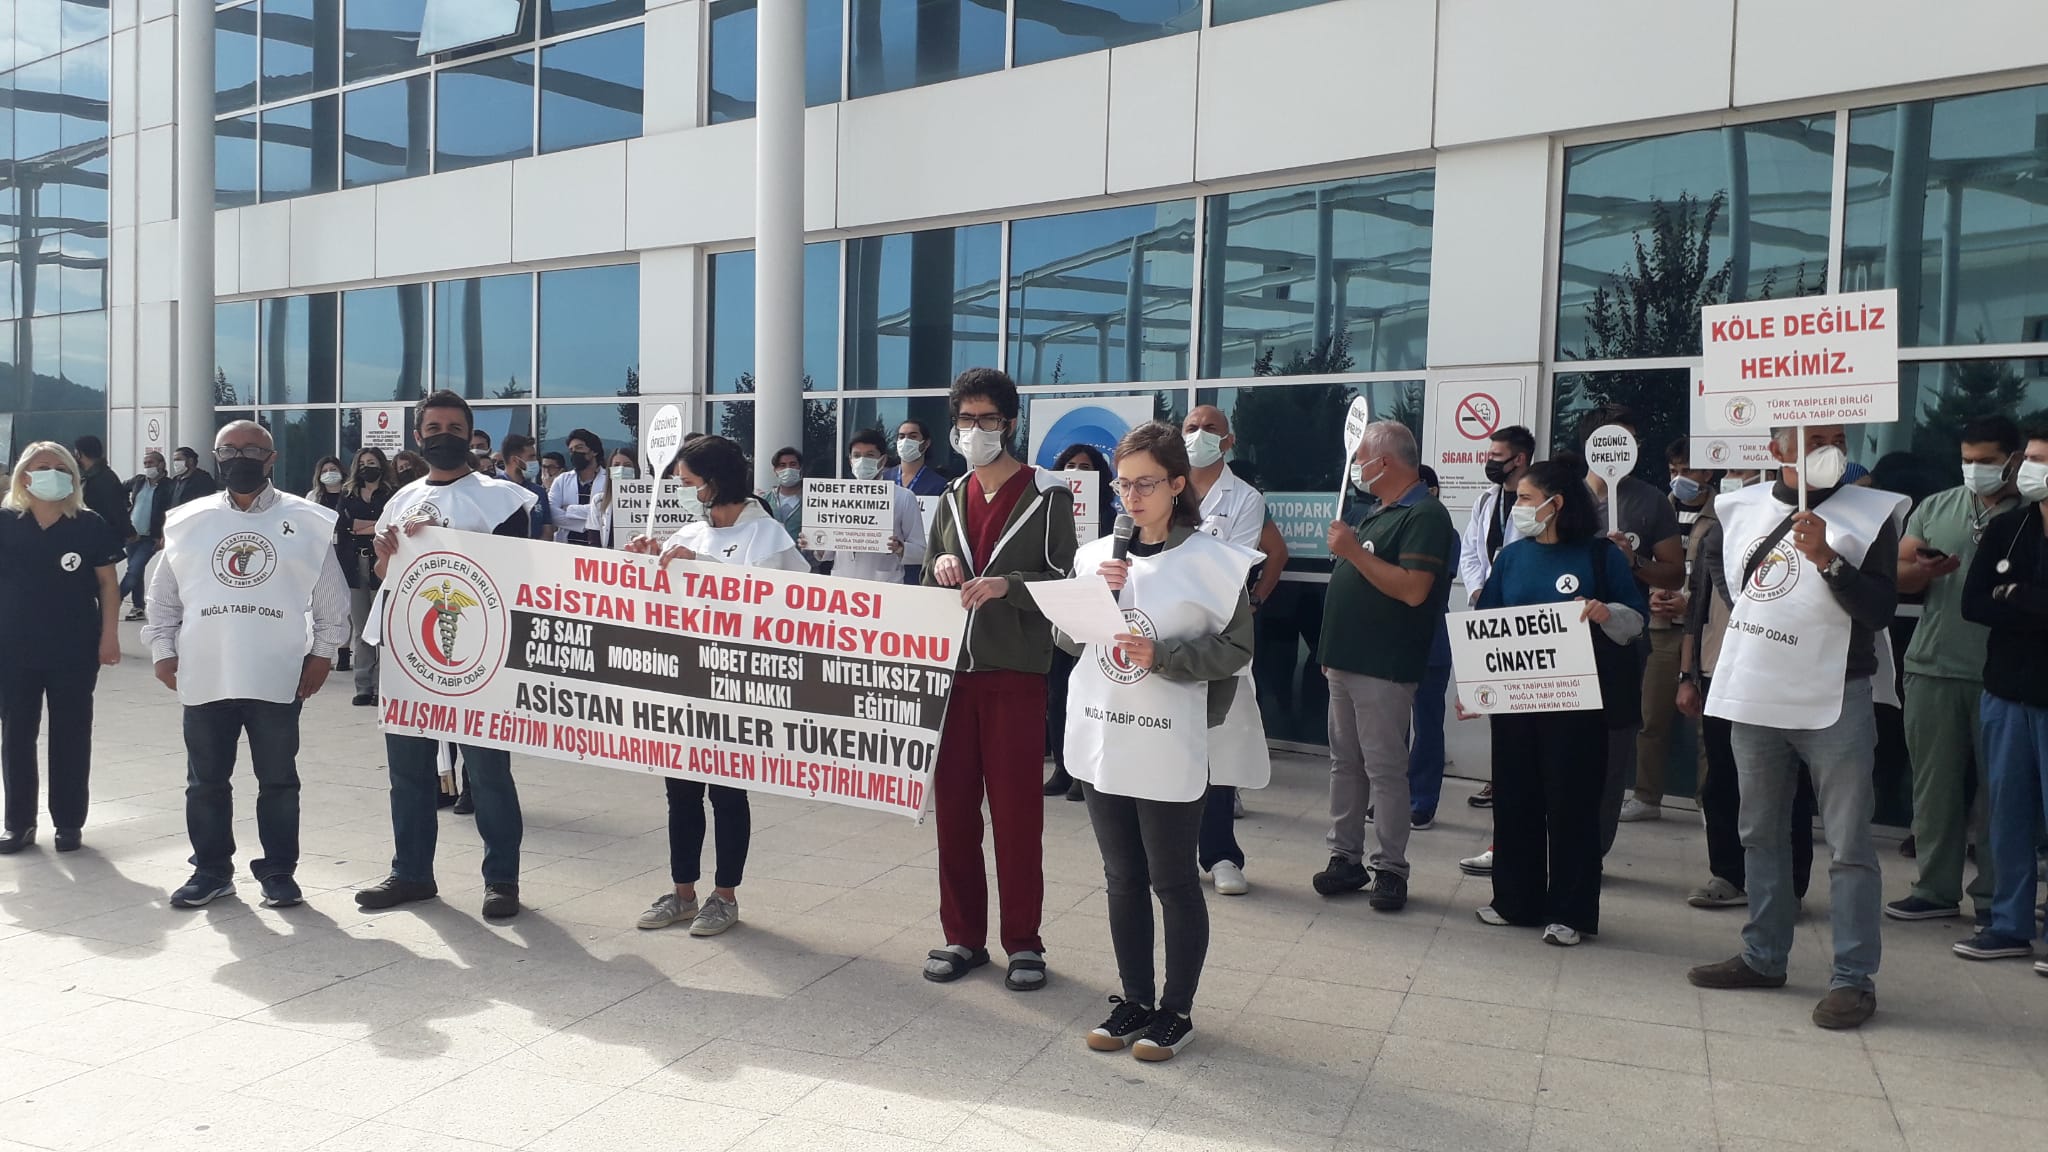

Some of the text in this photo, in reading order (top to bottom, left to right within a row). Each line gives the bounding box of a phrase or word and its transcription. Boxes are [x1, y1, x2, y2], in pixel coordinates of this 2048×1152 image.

[1712, 304, 1885, 342] KÖLE DEĞİLİZ
[1742, 348, 1853, 380] HEKİMİZ.
[1768, 394, 1873, 408] TÜRK TABİPLERİ BİRLİĞİ
[1773, 408, 1866, 420] MUĞLA TABİP ODASI
[1592, 434, 1628, 448] ÜZGÜNÜZ
[1442, 450, 1472, 464] SİGARA
[1592, 450, 1630, 462] ÖFKELİYİZ!
[620, 483, 653, 494] NÖBE
[810, 482, 888, 494] NÖBET ERTESİ
[618, 497, 642, 508] İZİN
[807, 496, 890, 510] İZİN HAKKIMIZI
[1268, 502, 1333, 518] OTOPARK
[630, 512, 698, 524] İSTYORUZ.
[818, 512, 878, 525] İSTİYORUZ.
[401, 556, 499, 610] TÜRK TABİPLERİ BİRLİĞİ
[574, 557, 882, 620] MUĞLA TABİP ODASI
[202, 604, 284, 618] MUĞLA TABİP ODASI
[516, 583, 950, 662] ASİSTAN HEKİM KOMİSYONU
[531, 618, 593, 647] 36 SAAT
[1466, 608, 1568, 640] KAZA DEĞİL
[1742, 622, 1764, 636] TABİP
[1766, 629, 1799, 646] ODASI
[525, 640, 594, 673] ÇALIŞMA
[608, 646, 679, 678] MOBBİNG
[699, 642, 803, 681] NÖBET ERTESİ
[1486, 648, 1556, 673] CİNAYET
[406, 652, 486, 688] MUĞLA TABİP ODASI
[822, 660, 950, 698] NİTELİKSİZ TIP
[710, 673, 792, 708] İZİN HAKKI
[1510, 692, 1534, 700] MUĞLA
[1536, 690, 1554, 699] TABİP
[516, 681, 624, 726] ASİSTAN
[633, 701, 774, 748] HEKİMLER
[854, 692, 920, 726] EĞİTİMİ
[1084, 706, 1172, 730] MUĞLA TABİP ODASI
[382, 696, 456, 735] ALIŞMA
[464, 708, 483, 737] VE
[492, 709, 548, 748] EĞİTİM
[553, 724, 682, 770] KOŞULLARIMIZ
[688, 744, 755, 781] ACİLEN
